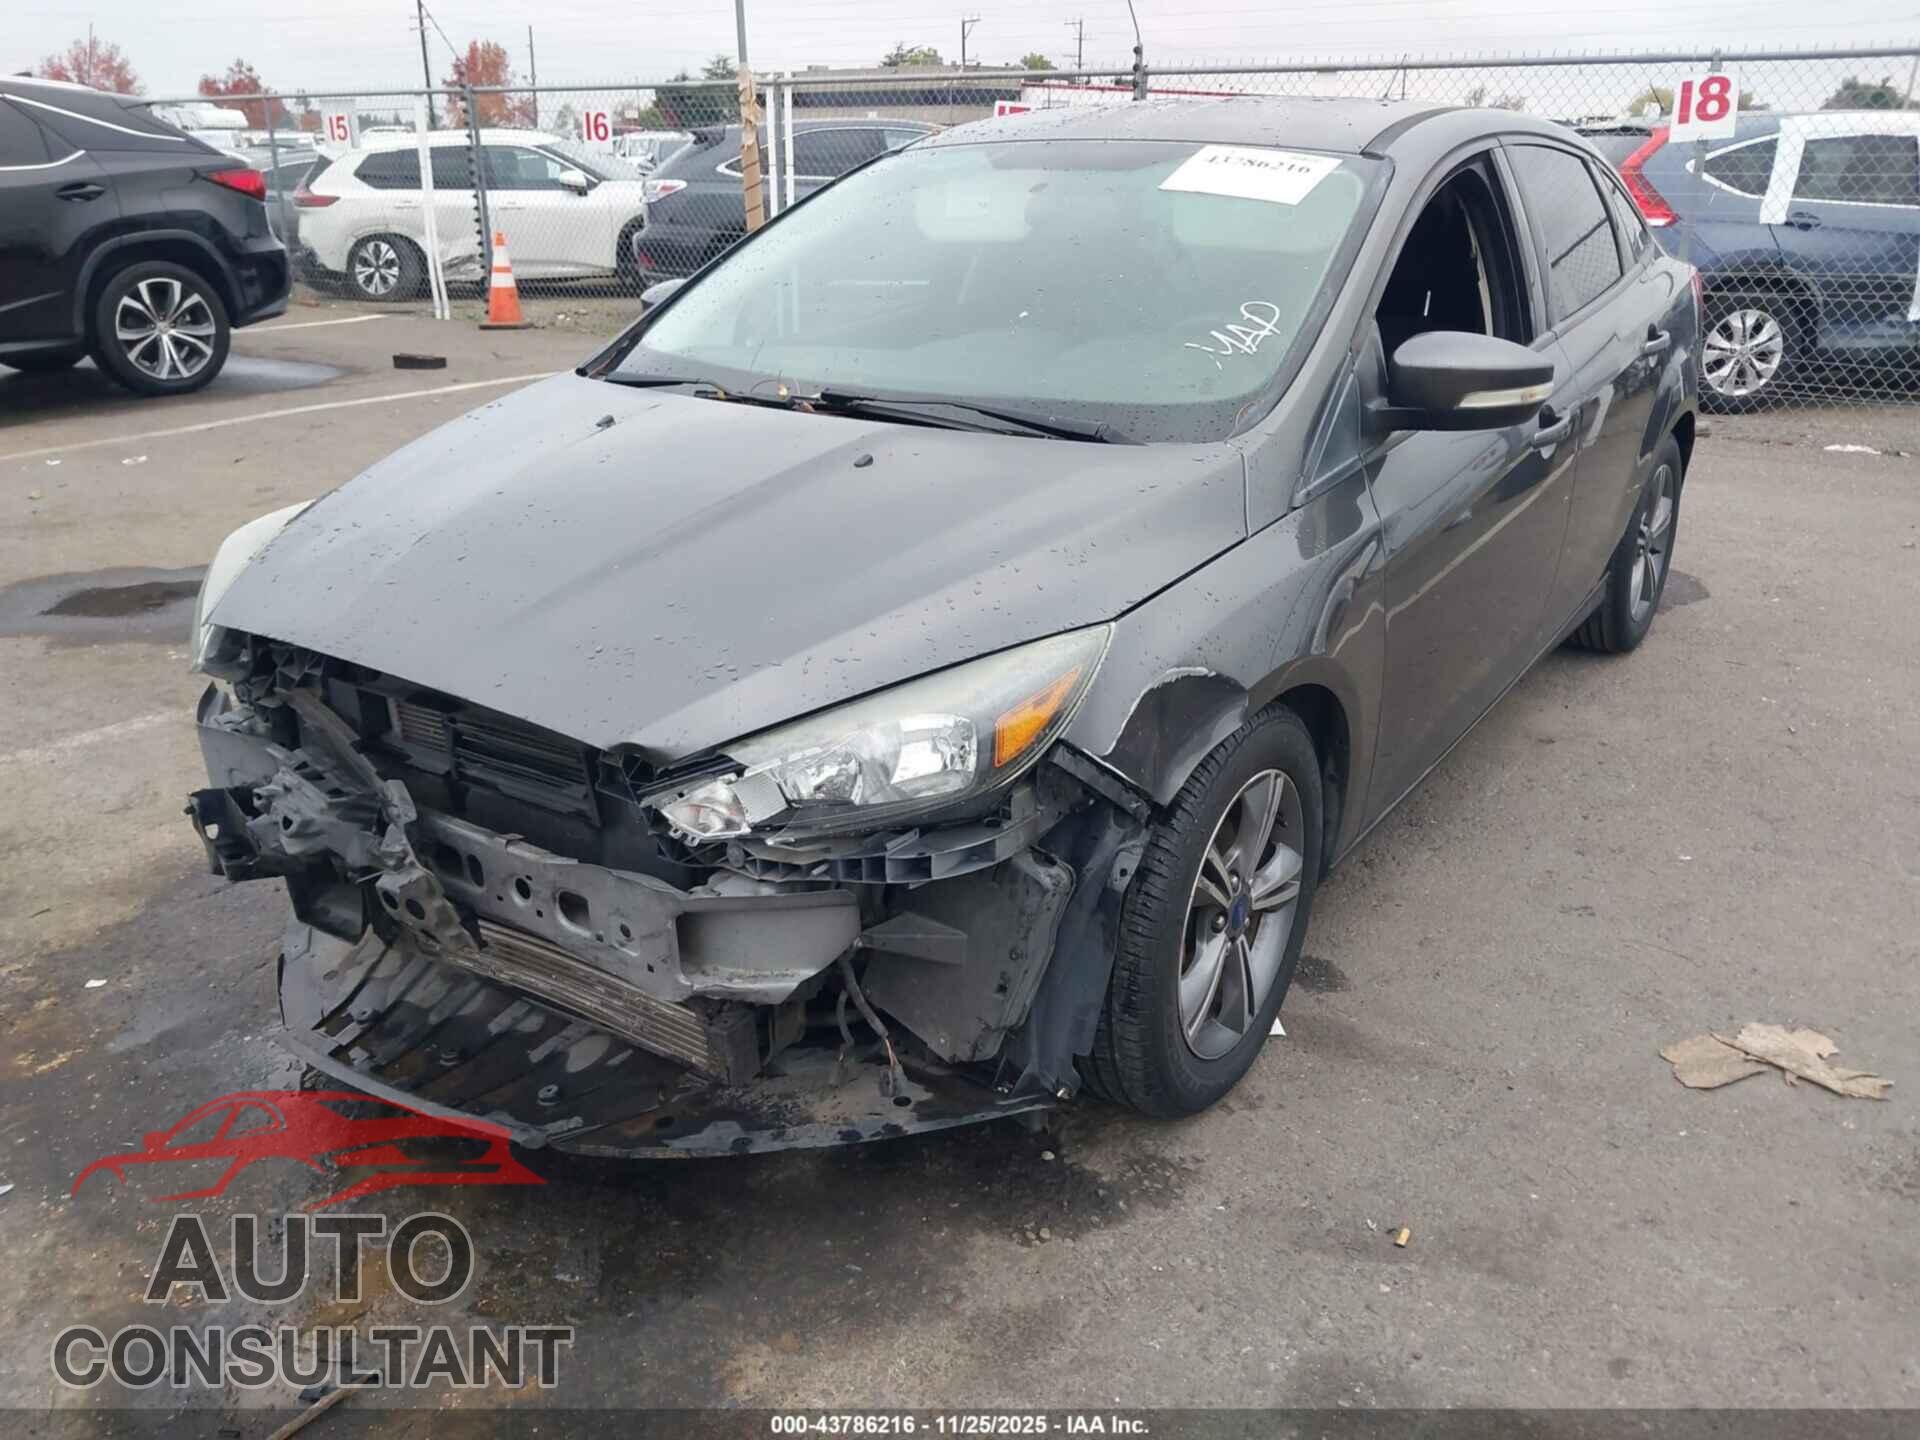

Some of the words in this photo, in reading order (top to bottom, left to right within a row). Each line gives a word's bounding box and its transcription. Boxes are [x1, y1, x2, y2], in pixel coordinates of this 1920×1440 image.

[1678, 75, 1731, 124] 18
[328, 115, 349, 141] 15
[585, 111, 609, 141] 16
